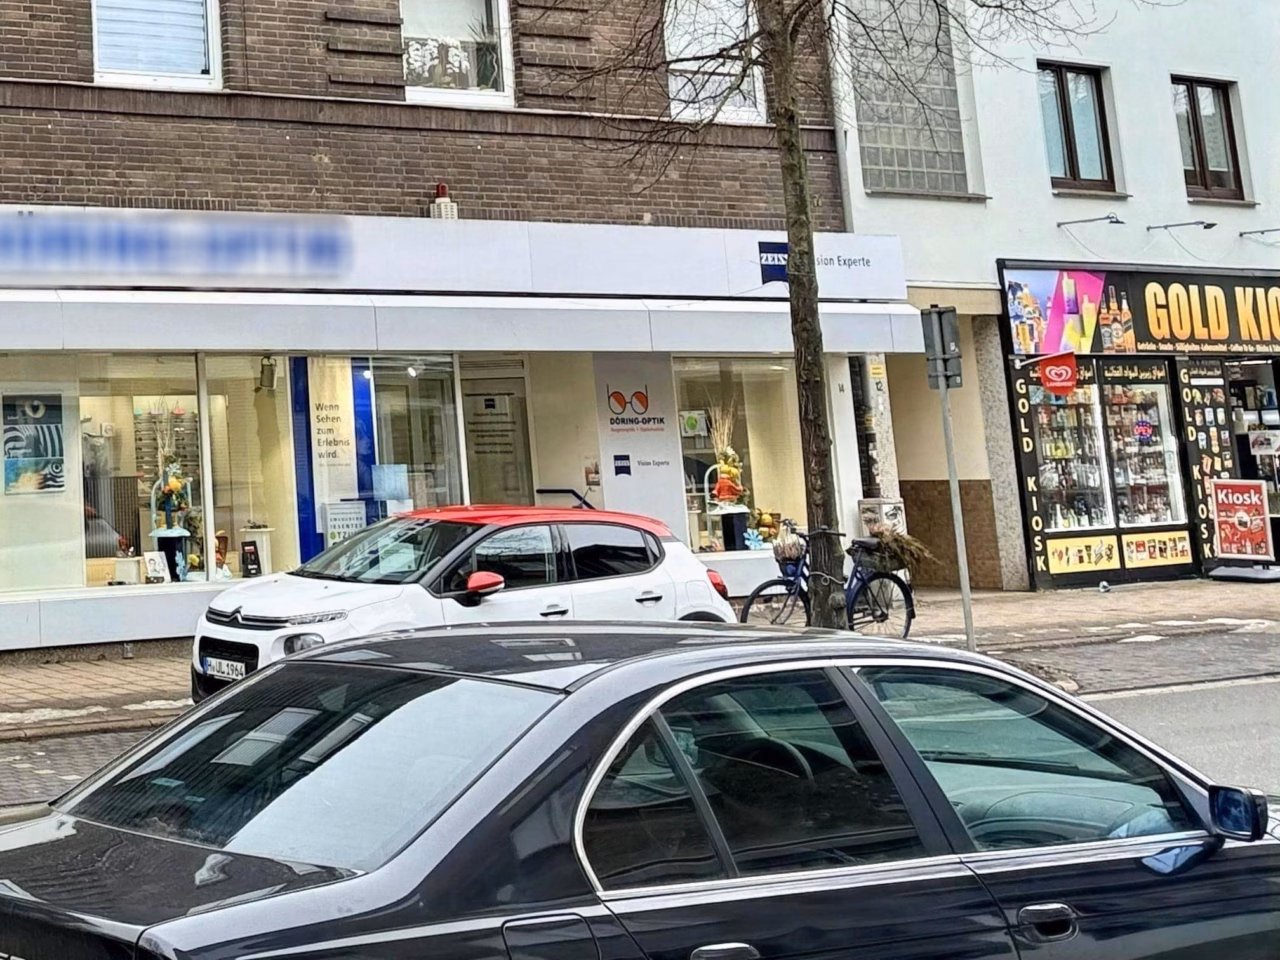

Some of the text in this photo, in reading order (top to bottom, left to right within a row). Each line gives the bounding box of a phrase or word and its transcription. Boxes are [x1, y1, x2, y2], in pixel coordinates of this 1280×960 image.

[816, 254, 871, 269] sion Experte
[1145, 282, 1280, 341] GOLD KIO
[315, 403, 339, 411] Wenn
[316, 415, 342, 423] Sehen
[610, 416, 665, 425] DÖRING-OPTIK
[317, 438, 350, 446] Erlebnis
[318, 450, 339, 458] wird.
[1180, 368, 1212, 558] GOLD KIOSK
[1016, 379, 1046, 571] GOLD KIOSK
[1217, 489, 1261, 505] Kiosk
